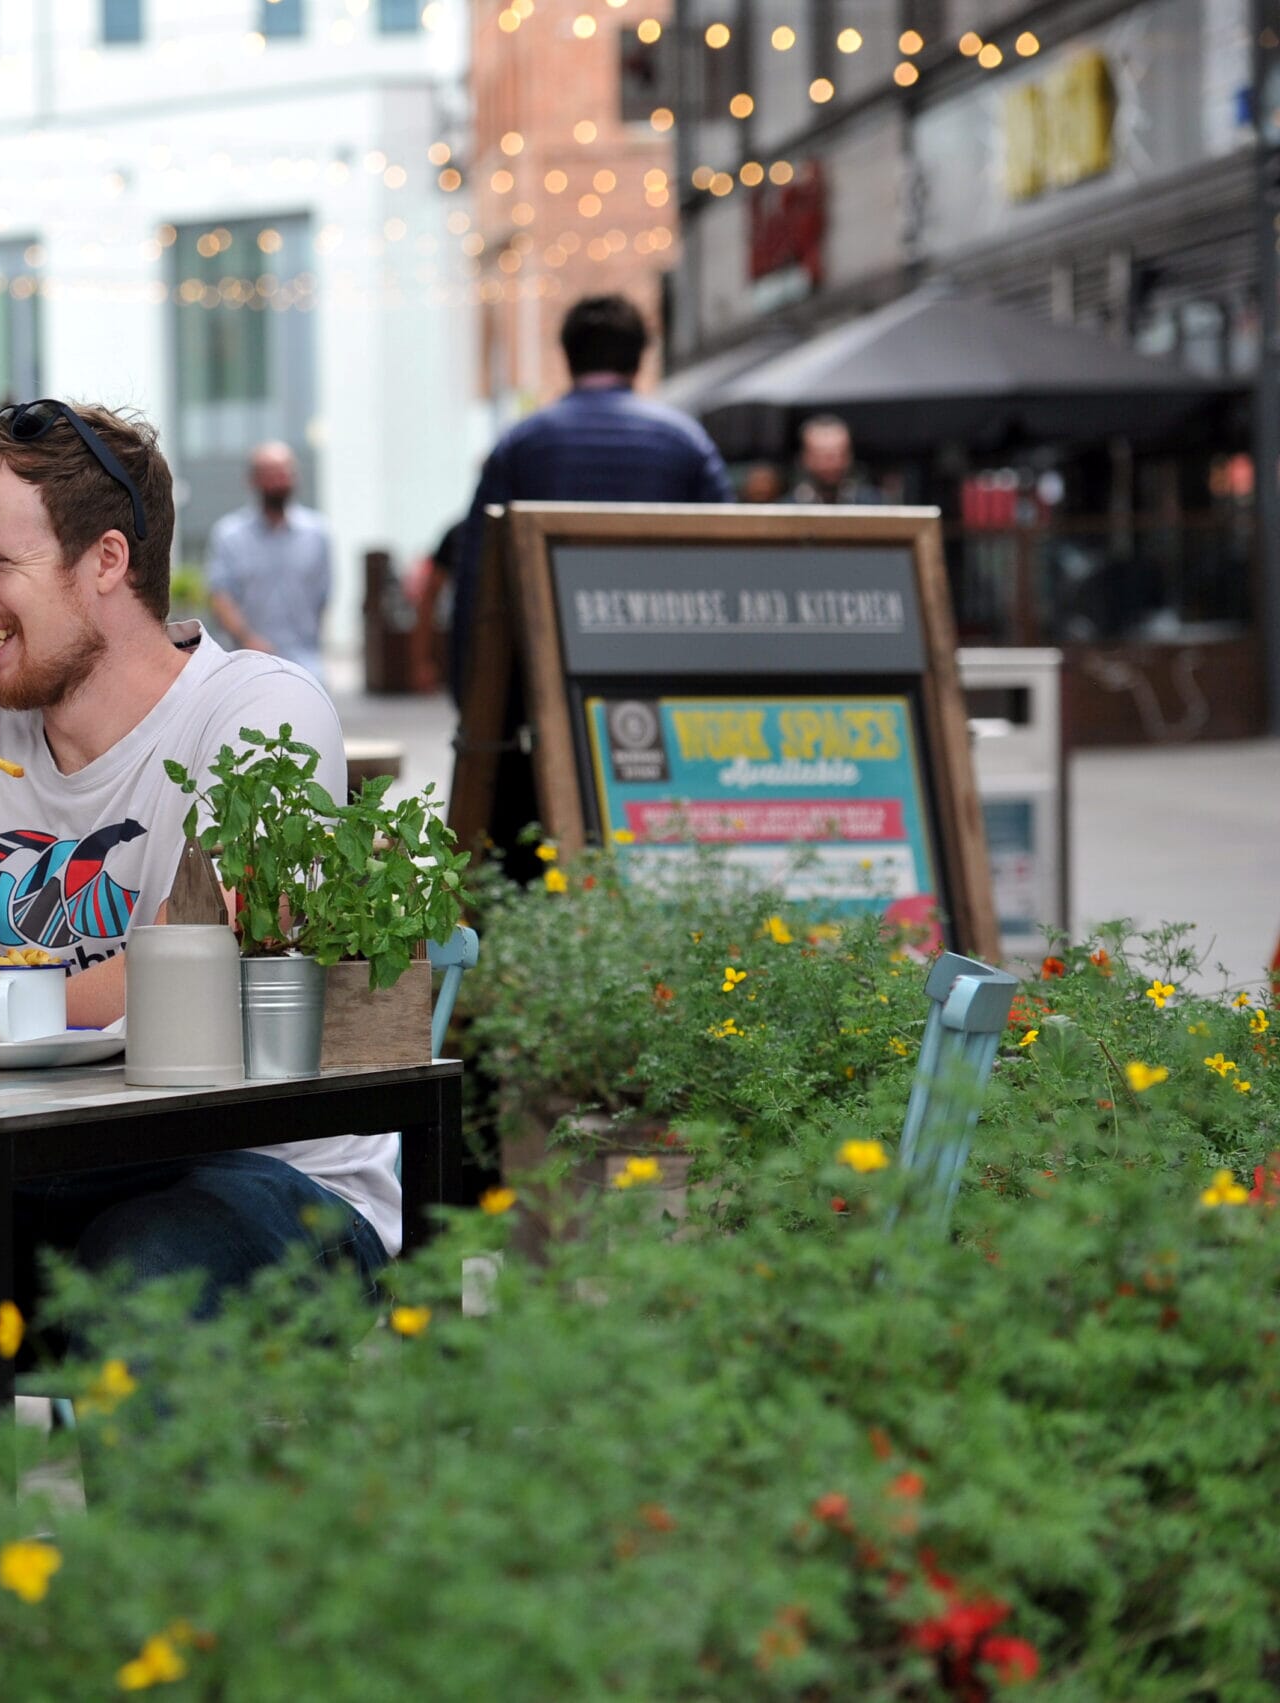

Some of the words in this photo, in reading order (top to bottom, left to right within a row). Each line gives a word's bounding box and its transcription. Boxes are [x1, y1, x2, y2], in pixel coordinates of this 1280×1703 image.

[737, 588, 789, 626] AND
[795, 588, 905, 626] KITCHEN
[672, 709, 772, 761] WORK
[778, 709, 901, 761] SPACES
